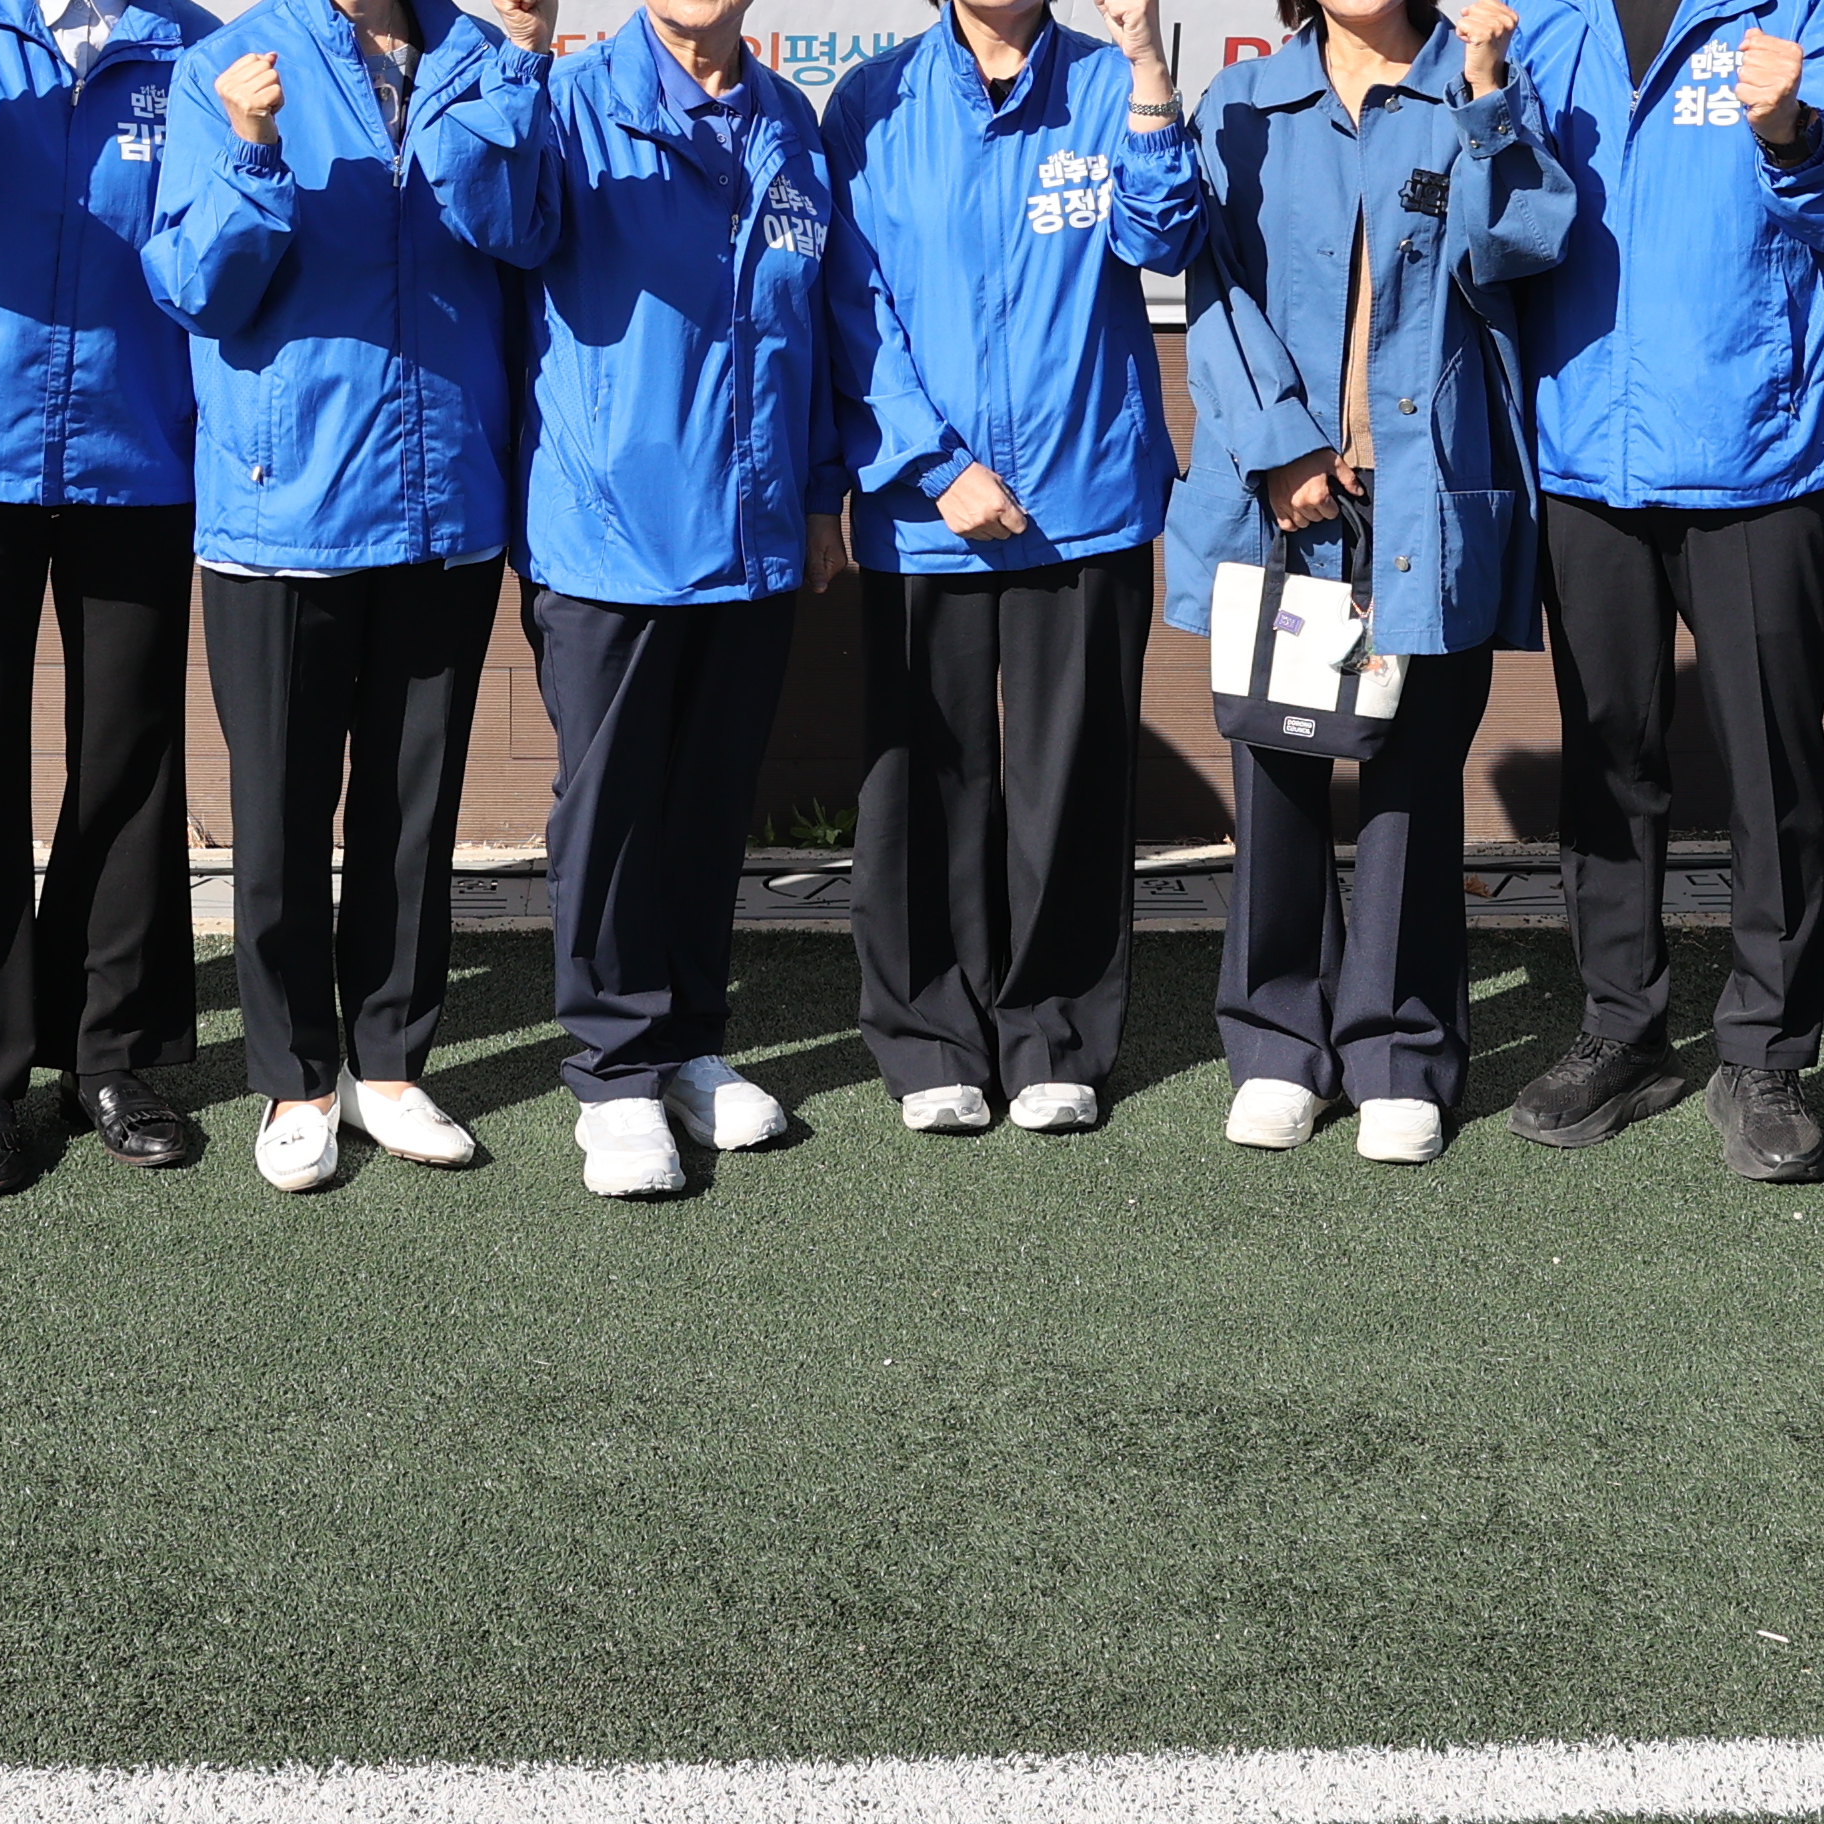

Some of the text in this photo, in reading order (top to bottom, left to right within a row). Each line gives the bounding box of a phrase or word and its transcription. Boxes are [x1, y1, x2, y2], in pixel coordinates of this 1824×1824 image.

[130, 92, 169, 119] 민주
[1672, 84, 1748, 126] 최승
[1038, 154, 1109, 188] 민주당
[768, 184, 818, 216] 민주당
